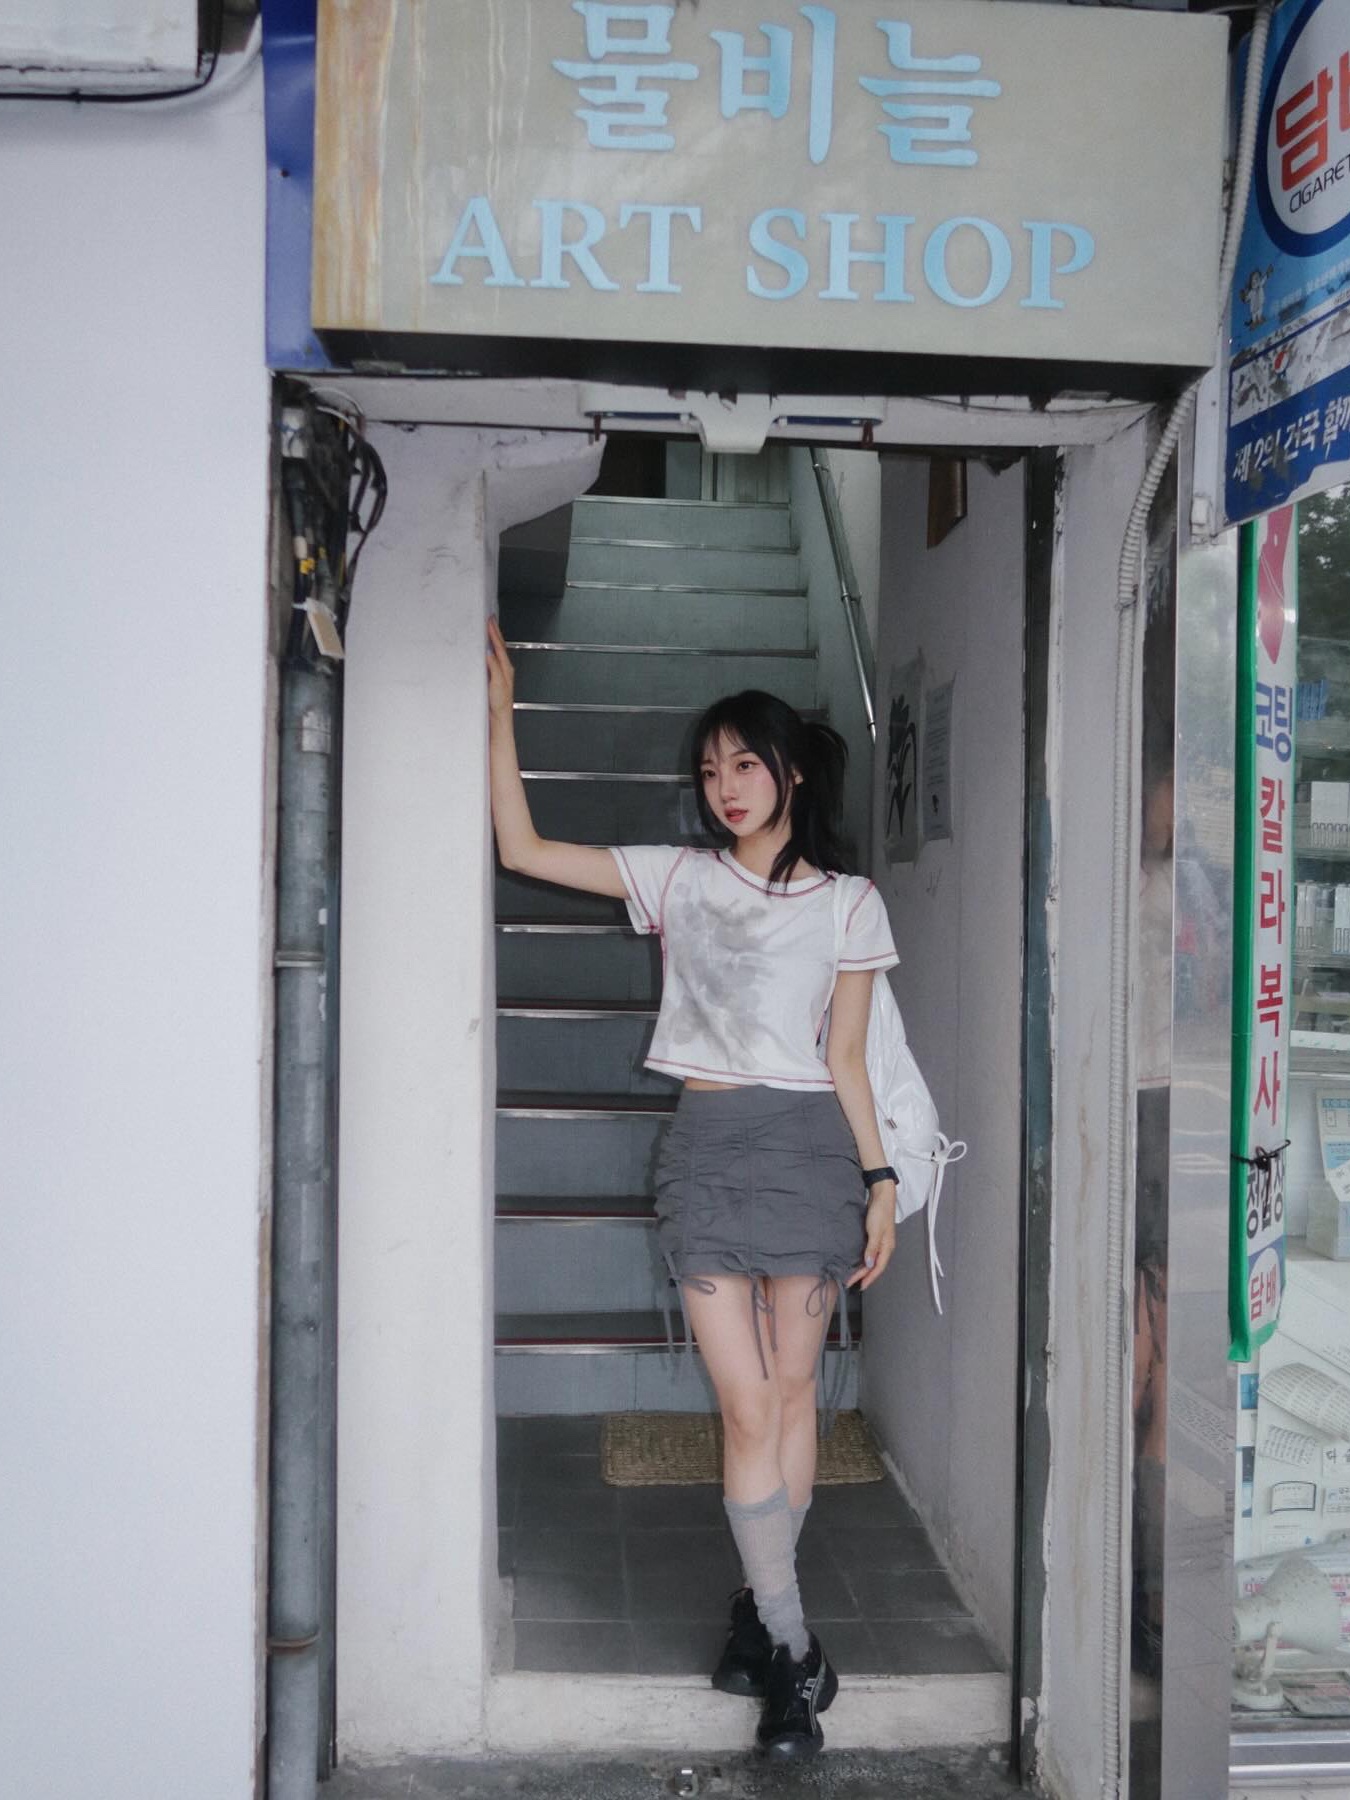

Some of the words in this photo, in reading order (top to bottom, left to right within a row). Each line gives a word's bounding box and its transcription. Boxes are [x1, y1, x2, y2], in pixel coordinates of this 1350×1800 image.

[552, 1, 1001, 167] 물비늘
[430, 195, 702, 295] ART
[747, 206, 1096, 310] SHOP
[1250, 1263, 1277, 1321] 담배
